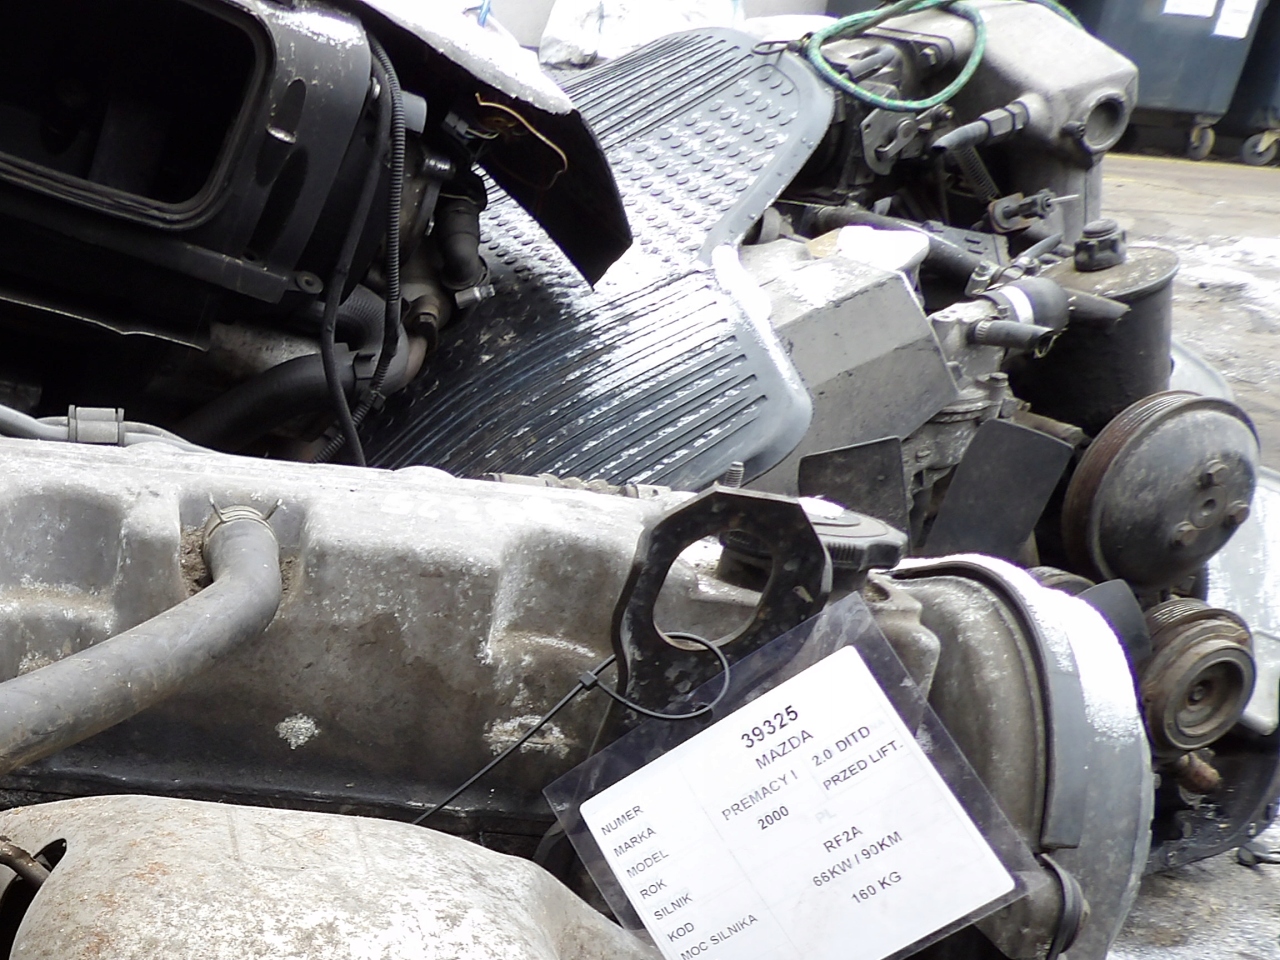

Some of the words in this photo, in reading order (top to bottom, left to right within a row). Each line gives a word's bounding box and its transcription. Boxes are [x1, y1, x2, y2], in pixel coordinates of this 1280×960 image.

[741, 705, 799, 748] 39325
[756, 729, 814, 770] MAZDA
[812, 749, 833, 766] 2.0
[835, 726, 870, 752] DITD
[823, 759, 868, 790] PRZED
[869, 740, 904, 764] LIFT.
[722, 773, 789, 821] PREMACY
[601, 805, 644, 835] NUMER
[757, 805, 789, 830] 2000
[613, 827, 657, 857] MARKA
[823, 826, 863, 853] RF2A
[626, 850, 669, 878] MODEL
[812, 858, 853, 887] 66KW
[861, 831, 903, 860] 90KM
[640, 879, 668, 900] ROK
[851, 885, 877, 904] 160
[877, 871, 902, 890] KG
[654, 893, 693, 920] SILNIK
[667, 922, 695, 943] KOD
[710, 914, 758, 946] SILNIKA
